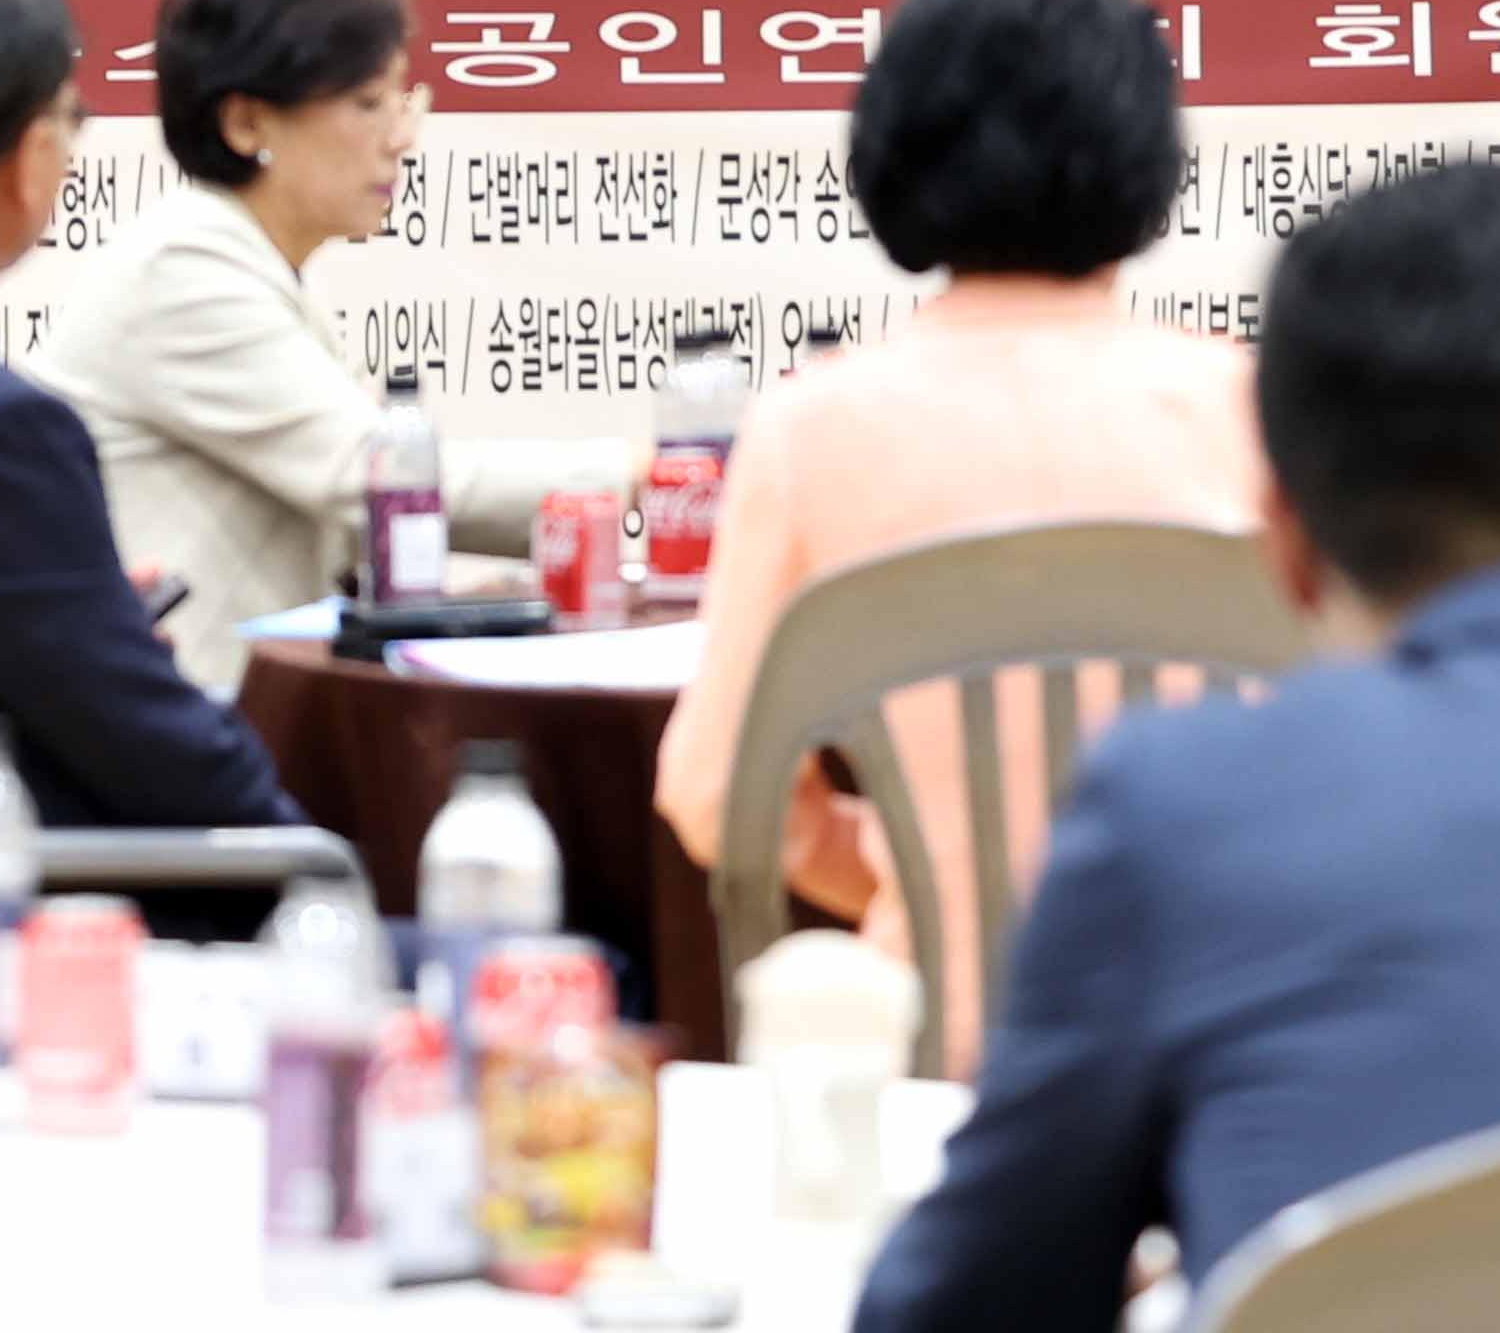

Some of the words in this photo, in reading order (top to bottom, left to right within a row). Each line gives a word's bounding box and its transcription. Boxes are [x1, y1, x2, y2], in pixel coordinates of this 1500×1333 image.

[468, 150, 579, 245] 단발머리
[594, 149, 678, 244] 전선화
[717, 148, 801, 244] 문성각
